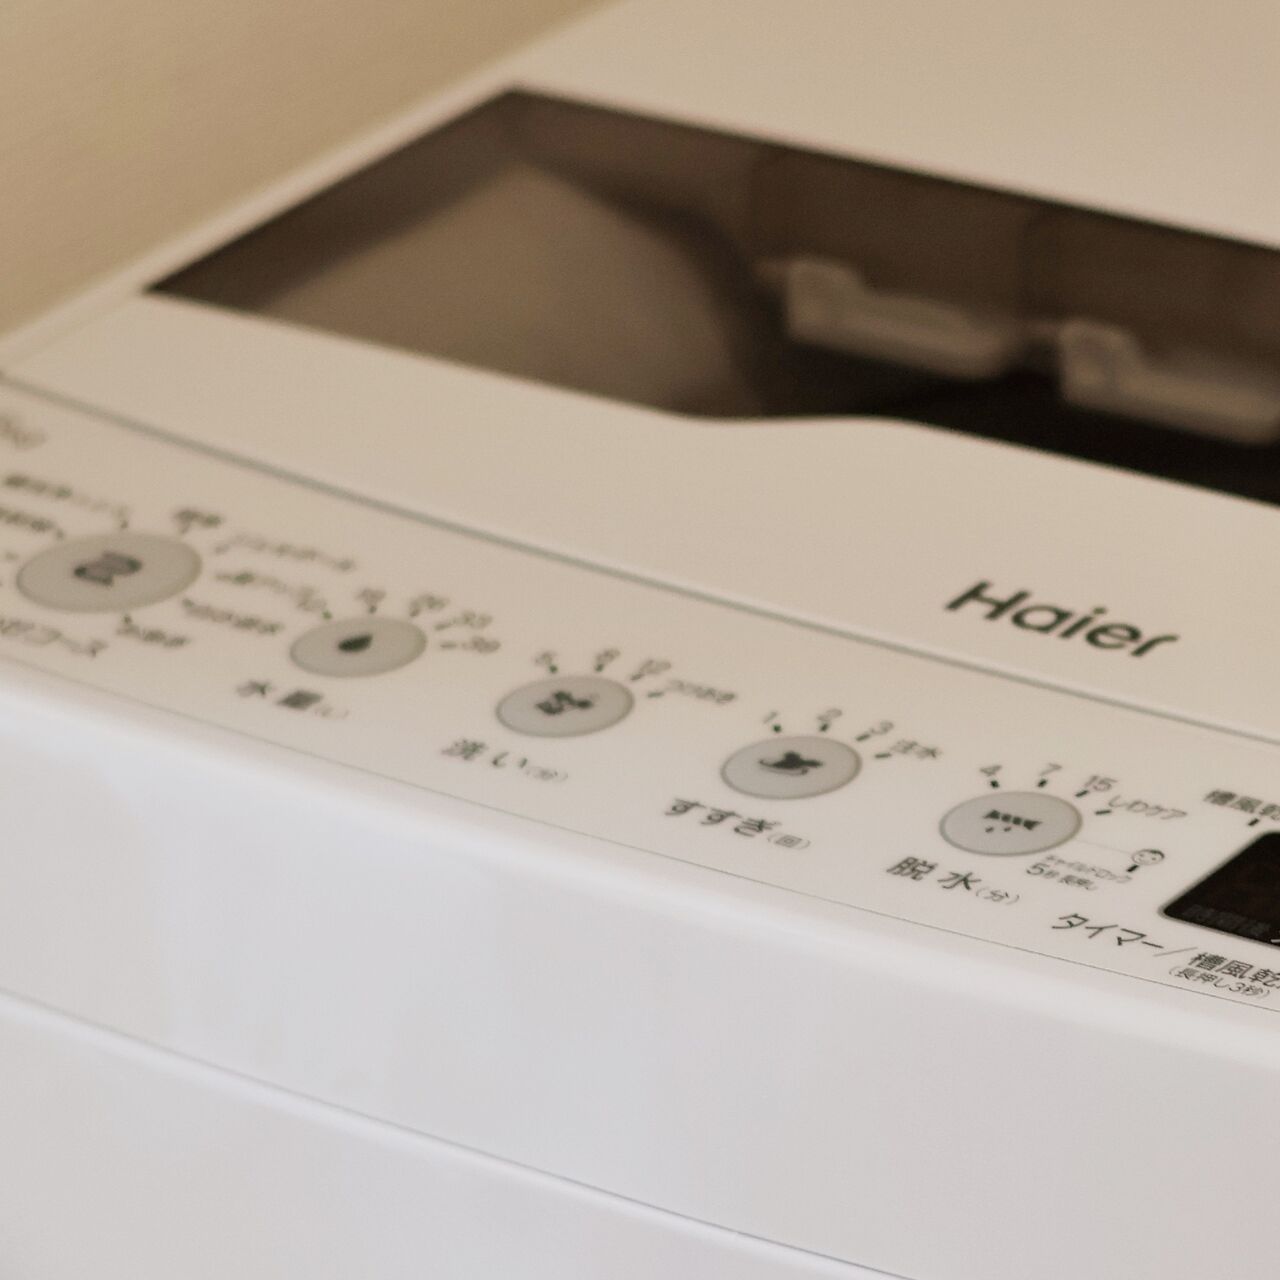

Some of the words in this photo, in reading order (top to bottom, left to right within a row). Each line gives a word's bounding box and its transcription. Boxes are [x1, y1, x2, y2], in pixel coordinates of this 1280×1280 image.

[945, 580, 1179, 657] Haier
[979, 764, 1002, 777] 4
[1083, 775, 1118, 793] 15
